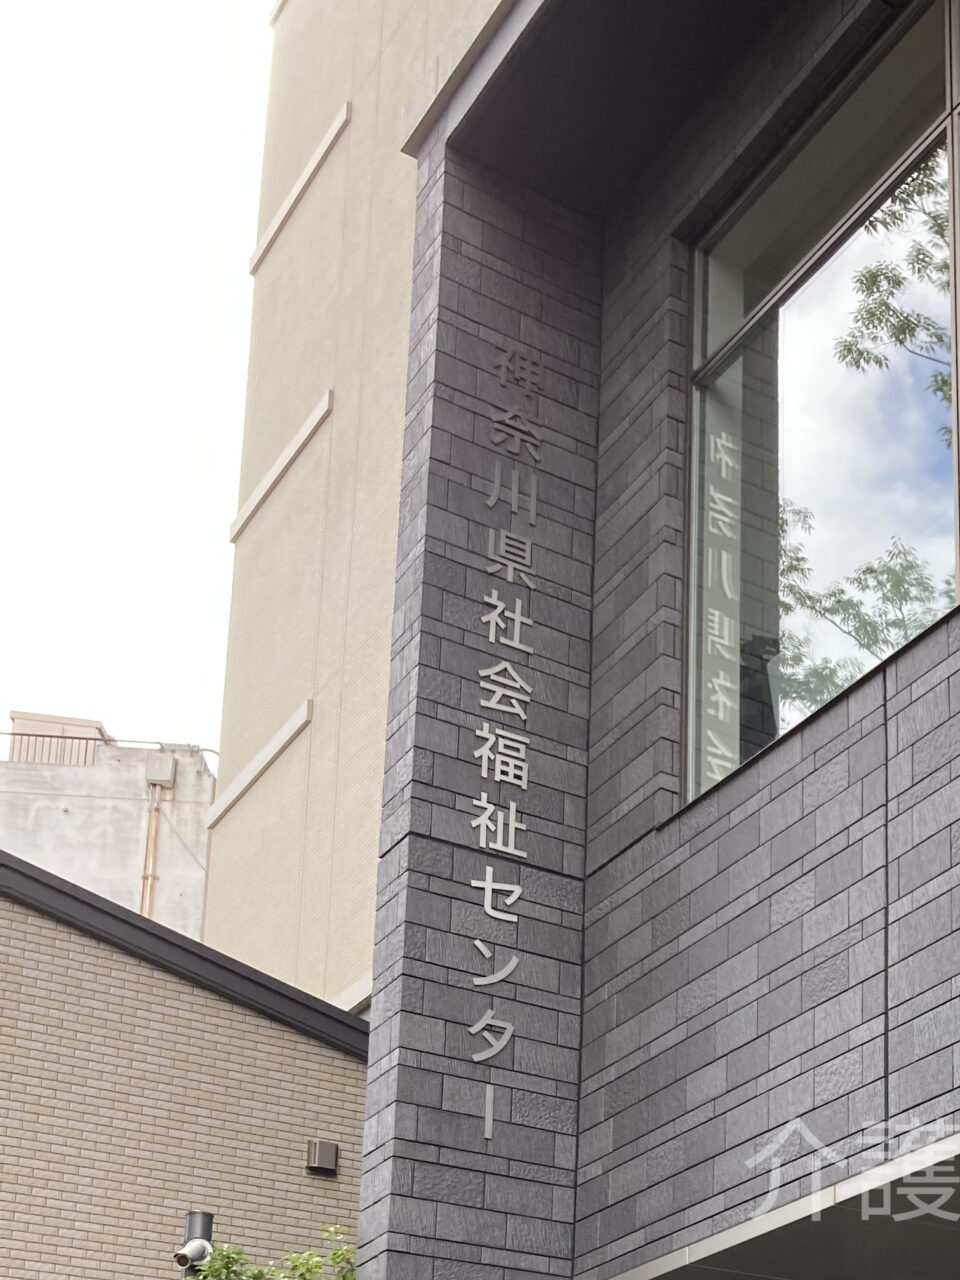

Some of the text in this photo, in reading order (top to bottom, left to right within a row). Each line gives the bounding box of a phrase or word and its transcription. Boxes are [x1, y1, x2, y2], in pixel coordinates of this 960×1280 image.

[468, 341, 544, 1140] 神奈川県社会福祉センター
